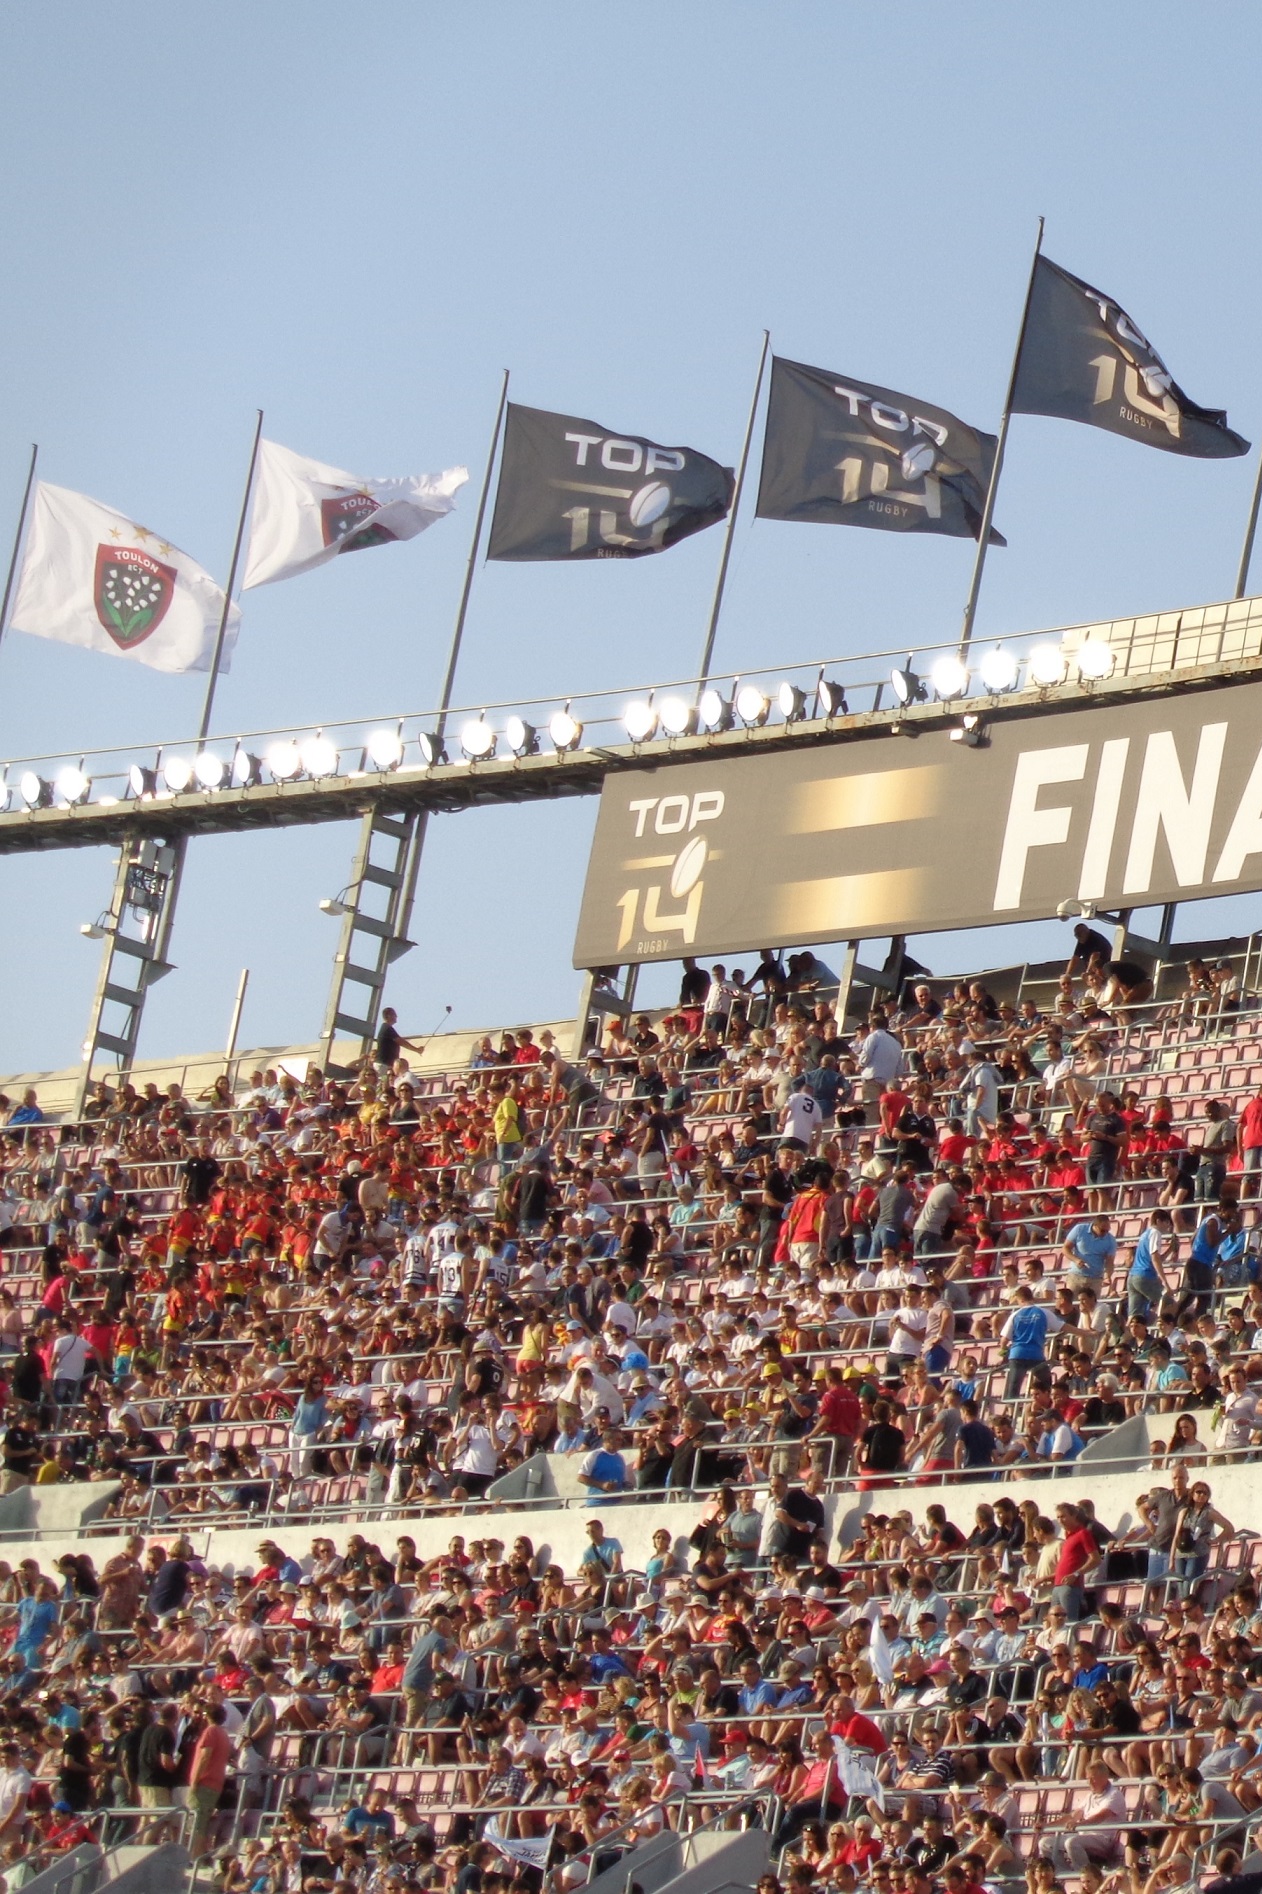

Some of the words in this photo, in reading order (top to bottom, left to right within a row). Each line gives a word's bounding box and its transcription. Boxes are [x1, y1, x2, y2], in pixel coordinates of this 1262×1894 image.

[834, 386, 949, 447] TOP
[1088, 354, 1182, 439] 14
[1119, 406, 1153, 430] RUGBY
[565, 432, 686, 476] TOP
[833, 457, 942, 519] 14
[868, 501, 909, 518] RUGBY
[561, 506, 670, 552] 14
[114, 551, 159, 574] TOULON
[127, 564, 143, 575] RCT
[629, 790, 726, 838] TOP
[615, 880, 704, 952] 14
[636, 938, 670, 955] RUGBY
[802, 1097, 815, 1115] 3
